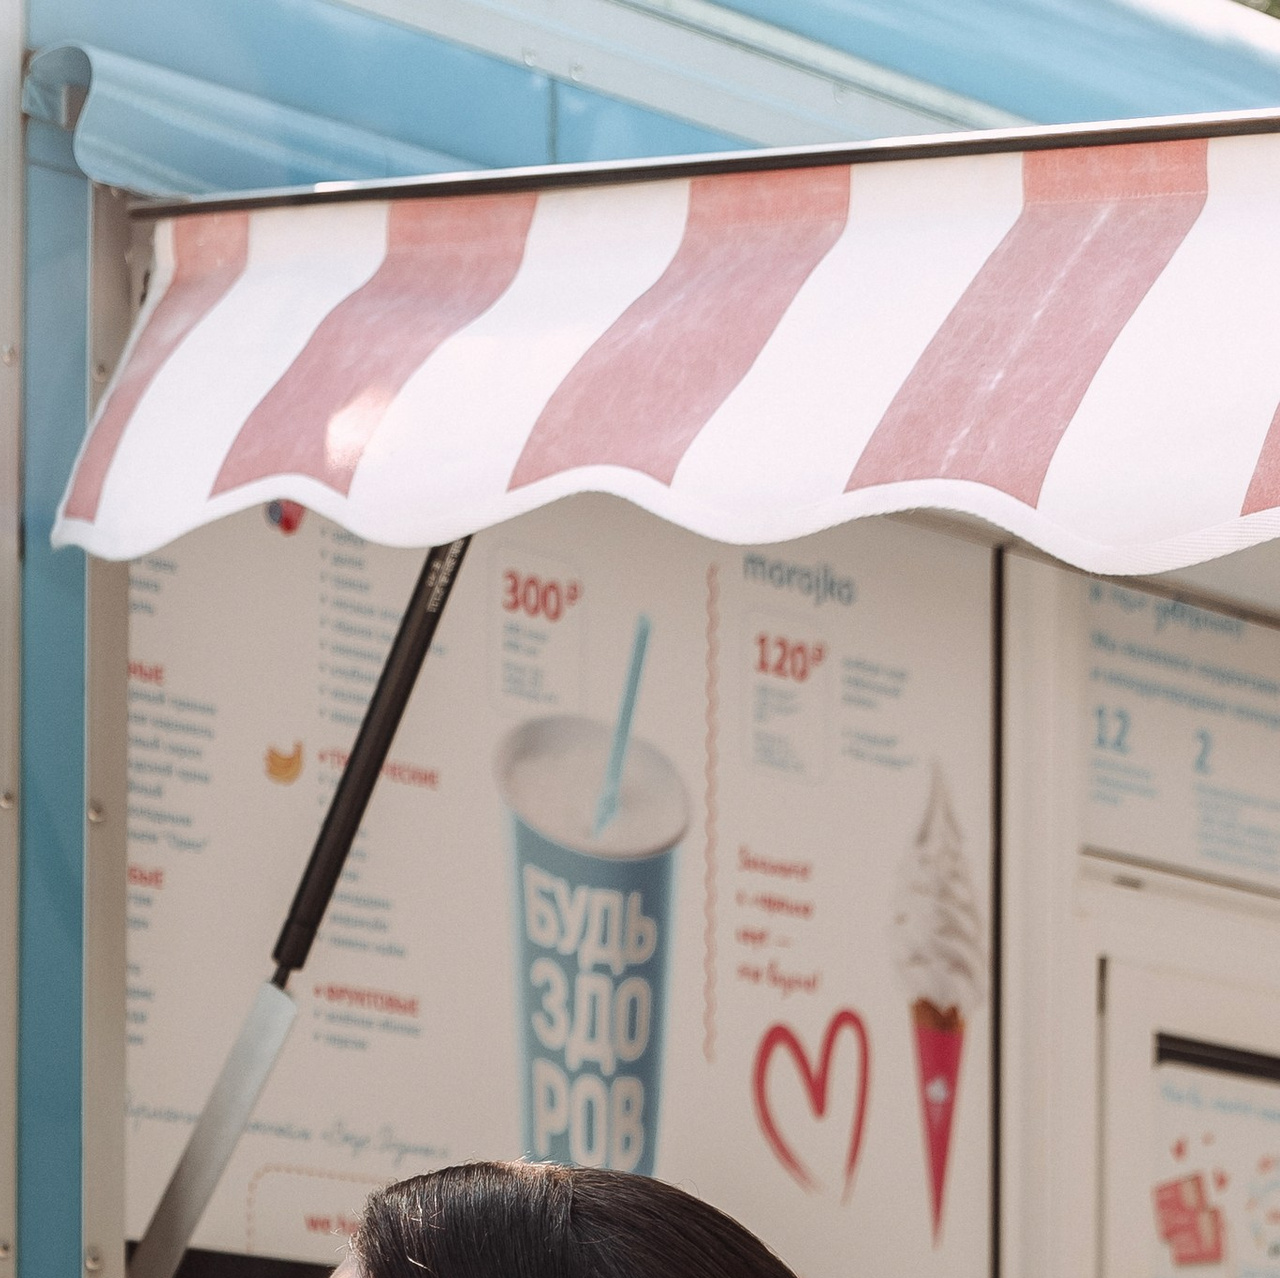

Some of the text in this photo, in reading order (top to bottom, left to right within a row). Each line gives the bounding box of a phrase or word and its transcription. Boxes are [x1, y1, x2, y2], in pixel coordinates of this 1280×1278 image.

[523, 864, 658, 976] БУДЬ
[530, 957, 652, 1076] ЗДО
[532, 1058, 645, 1172] РОВ
